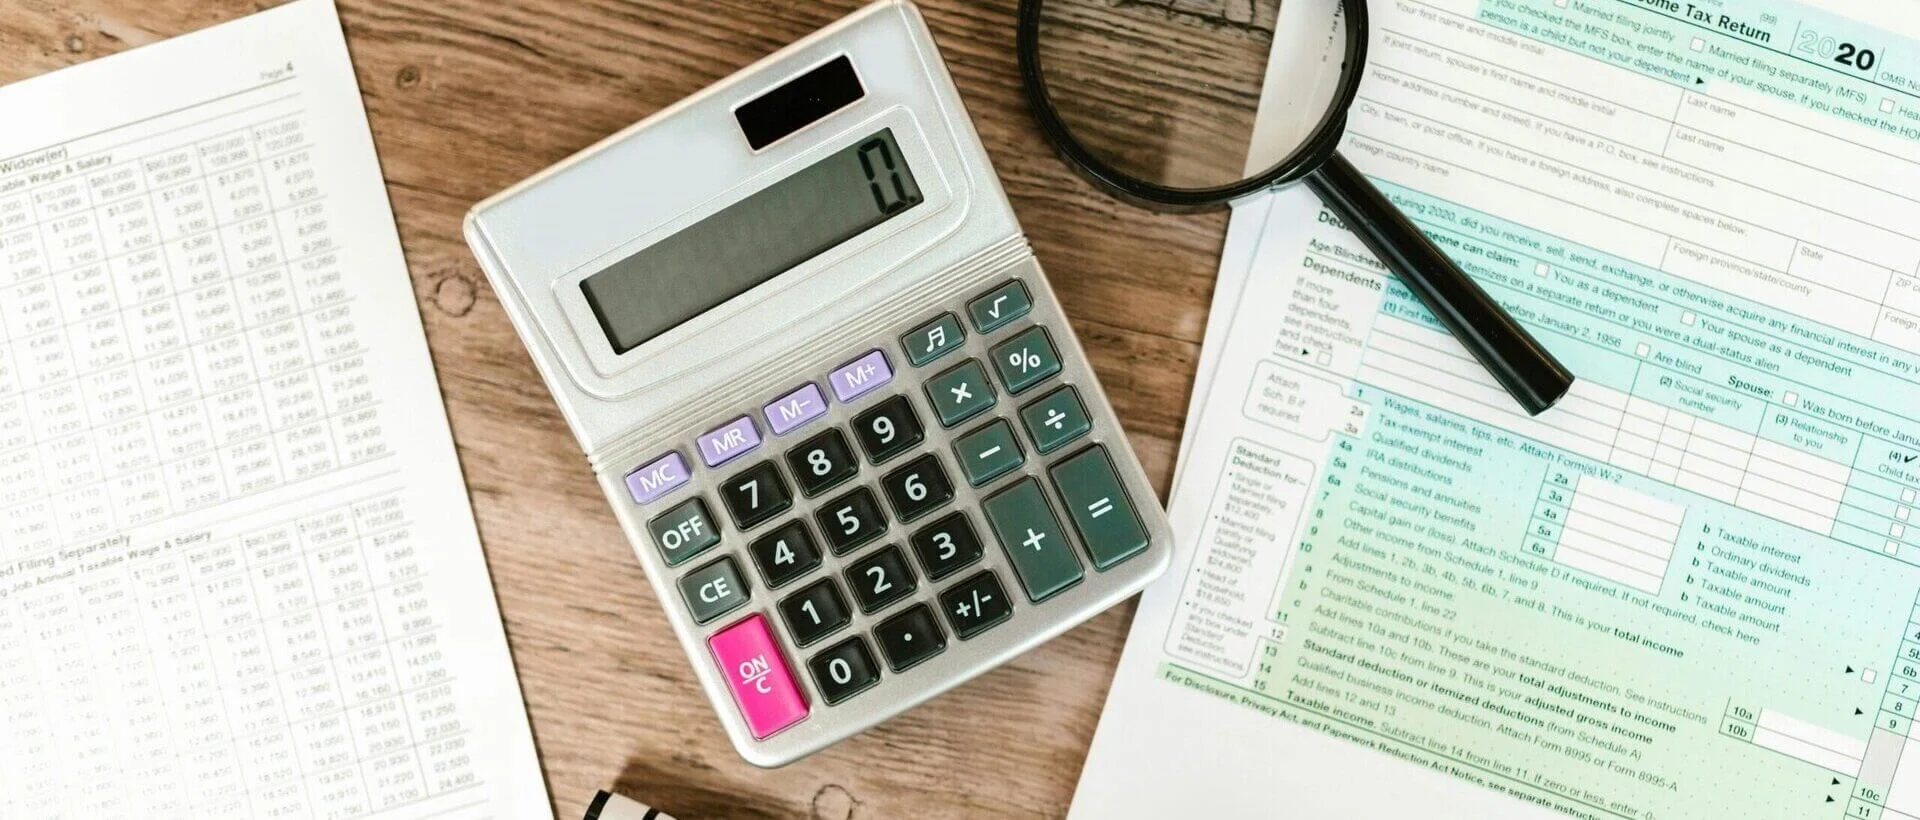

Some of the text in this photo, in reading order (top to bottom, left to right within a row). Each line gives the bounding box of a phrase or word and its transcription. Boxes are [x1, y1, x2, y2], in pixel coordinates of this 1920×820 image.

[1571, 0, 1675, 45] Married filing jointly
[1683, 3, 1713, 24] Tax
[1716, 14, 1772, 43] Return
[1795, 27, 1878, 73] 2020
[1516, 4, 1564, 25] checked
[1563, 18, 1583, 32] the
[1582, 24, 1611, 41] MFS
[1610, 32, 1634, 50] box,
[1635, 42, 1665, 59] enter
[1665, 51, 1685, 65] the
[1684, 58, 1717, 75] name
[1717, 69, 1731, 80] of
[1729, 73, 1756, 88] your
[1755, 82, 1798, 102] spouse.
[1799, 94, 1810, 105] If
[1808, 99, 1831, 113] you
[1831, 106, 1879, 128] checked
[1878, 120, 1897, 134] the
[1707, 45, 1868, 107] Married filing separately (MFS)
[1686, 94, 1737, 118] Last name
[1302, 256, 1382, 292] Dependents
[1600, 263, 1912, 374] exchange, or otherwise acquire any financial interest in any
[1010, 348, 1040, 372] %
[1698, 319, 1853, 377] Your spouse as a dependent
[845, 364, 876, 388] M+
[1653, 351, 1703, 375] Are blind
[1658, 374, 1743, 412] (2) Social security
[1726, 375, 1774, 398] Spouse:
[1677, 395, 1716, 414] number
[1800, 399, 1888, 436] Was born before
[712, 428, 746, 454] MR
[873, 417, 894, 443] 9
[1381, 397, 1623, 483] Wages, salaries, tips, etc. Attach Form(s) W-2
[1774, 412, 1849, 447] (3) Relationship
[1803, 437, 1824, 450] you
[808, 450, 831, 475] 8
[1876, 462, 1904, 479] Child
[640, 463, 676, 493] MC
[906, 474, 926, 500] 6
[740, 480, 757, 508] 7
[837, 506, 859, 534] 5
[662, 516, 703, 551] OFF
[936, 533, 955, 559] 3
[1023, 529, 1045, 550] +
[1701, 523, 1802, 565] b Taxable interest
[775, 540, 794, 564] 4
[1696, 541, 1811, 587] b Ordinary dividends
[700, 577, 730, 602] CE
[867, 567, 891, 593] 2
[802, 600, 820, 624] 1
[957, 590, 991, 617] +/-
[1612, 627, 1685, 659] total income
[739, 654, 770, 679] ON
[830, 659, 851, 683] 0
[756, 676, 772, 694] C
[1302, 639, 1545, 728] Standard deduction or itemized deductions
[1517, 673, 1677, 733] total adjustments to income
[1732, 706, 1754, 721] 10a
[1523, 695, 1653, 745] adjusted gross income
[1726, 723, 1749, 738] 10b
[1164, 669, 1553, 808] For Disclosure, Privacy Act, and Paperwork Reduction Act Notice, see separate
[1859, 787, 1881, 802] 10c
